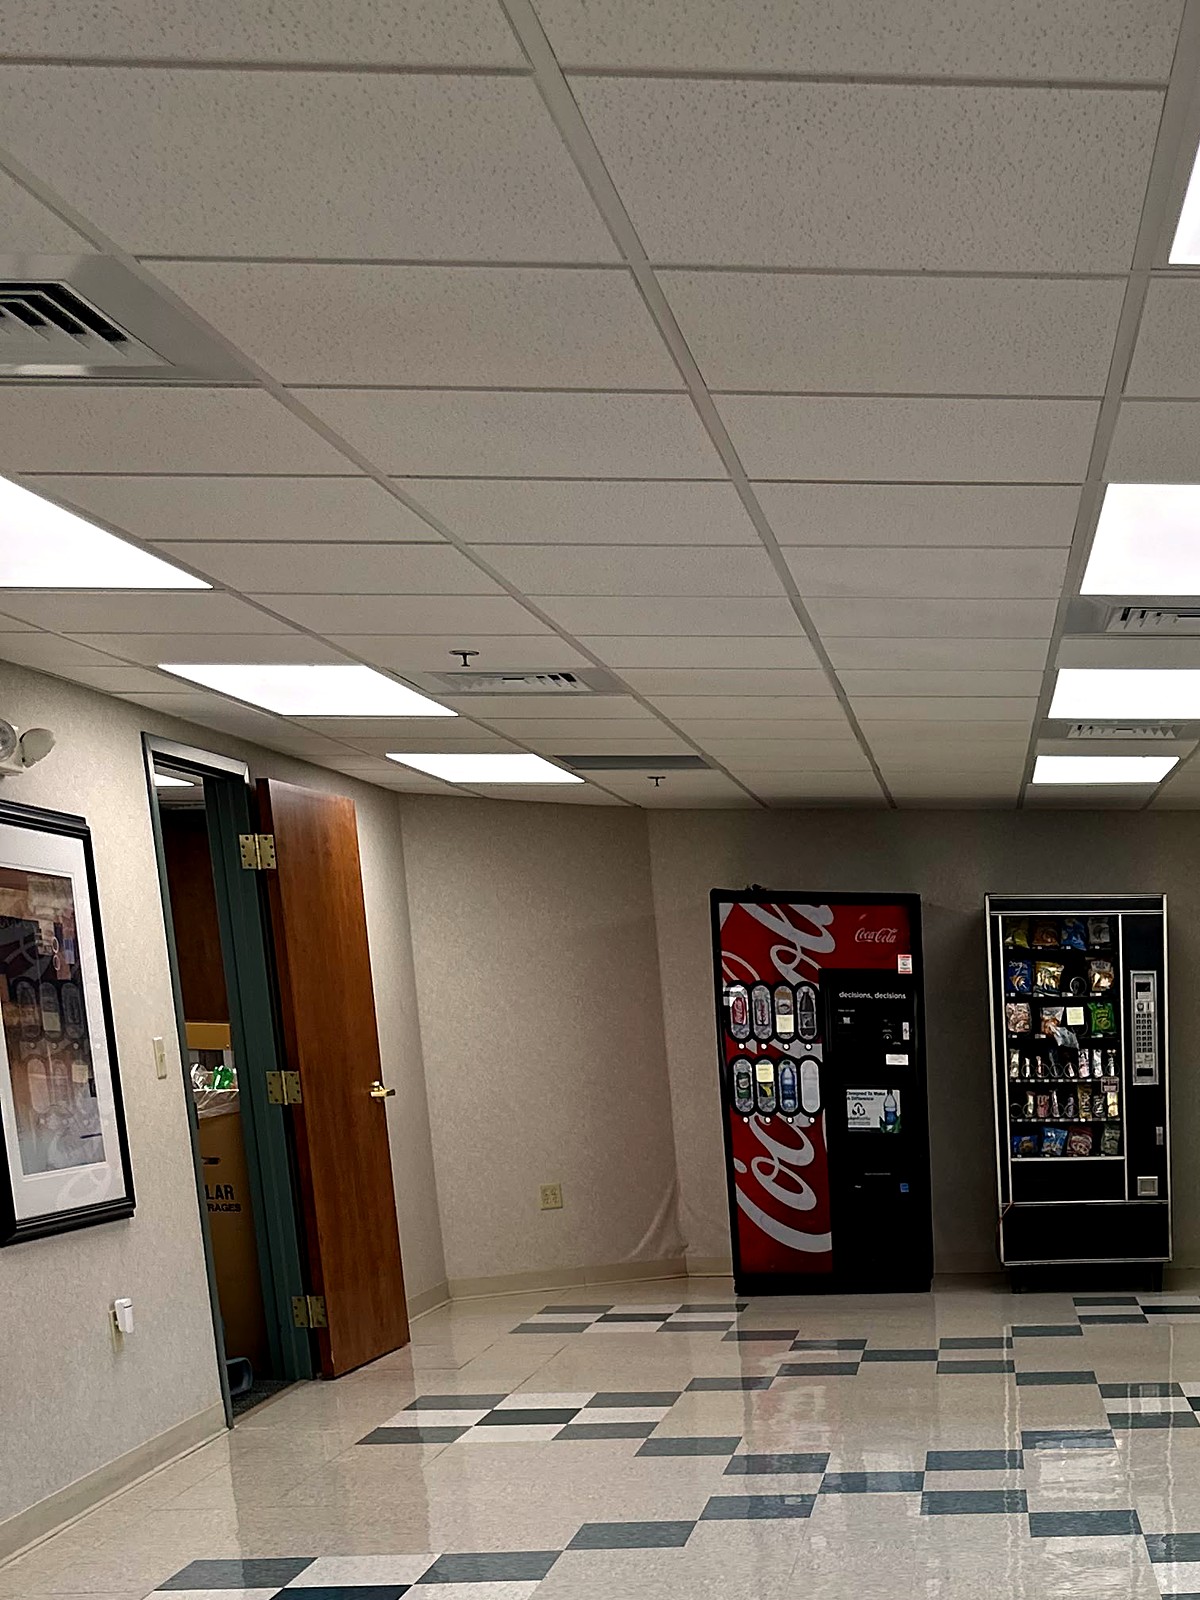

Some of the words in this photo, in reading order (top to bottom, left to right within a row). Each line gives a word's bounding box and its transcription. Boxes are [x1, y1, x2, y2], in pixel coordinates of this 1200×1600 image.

[839, 991, 873, 999] decisions,
[204, 1184, 235, 1200] LAR
[206, 1203, 242, 1212] RAGES
